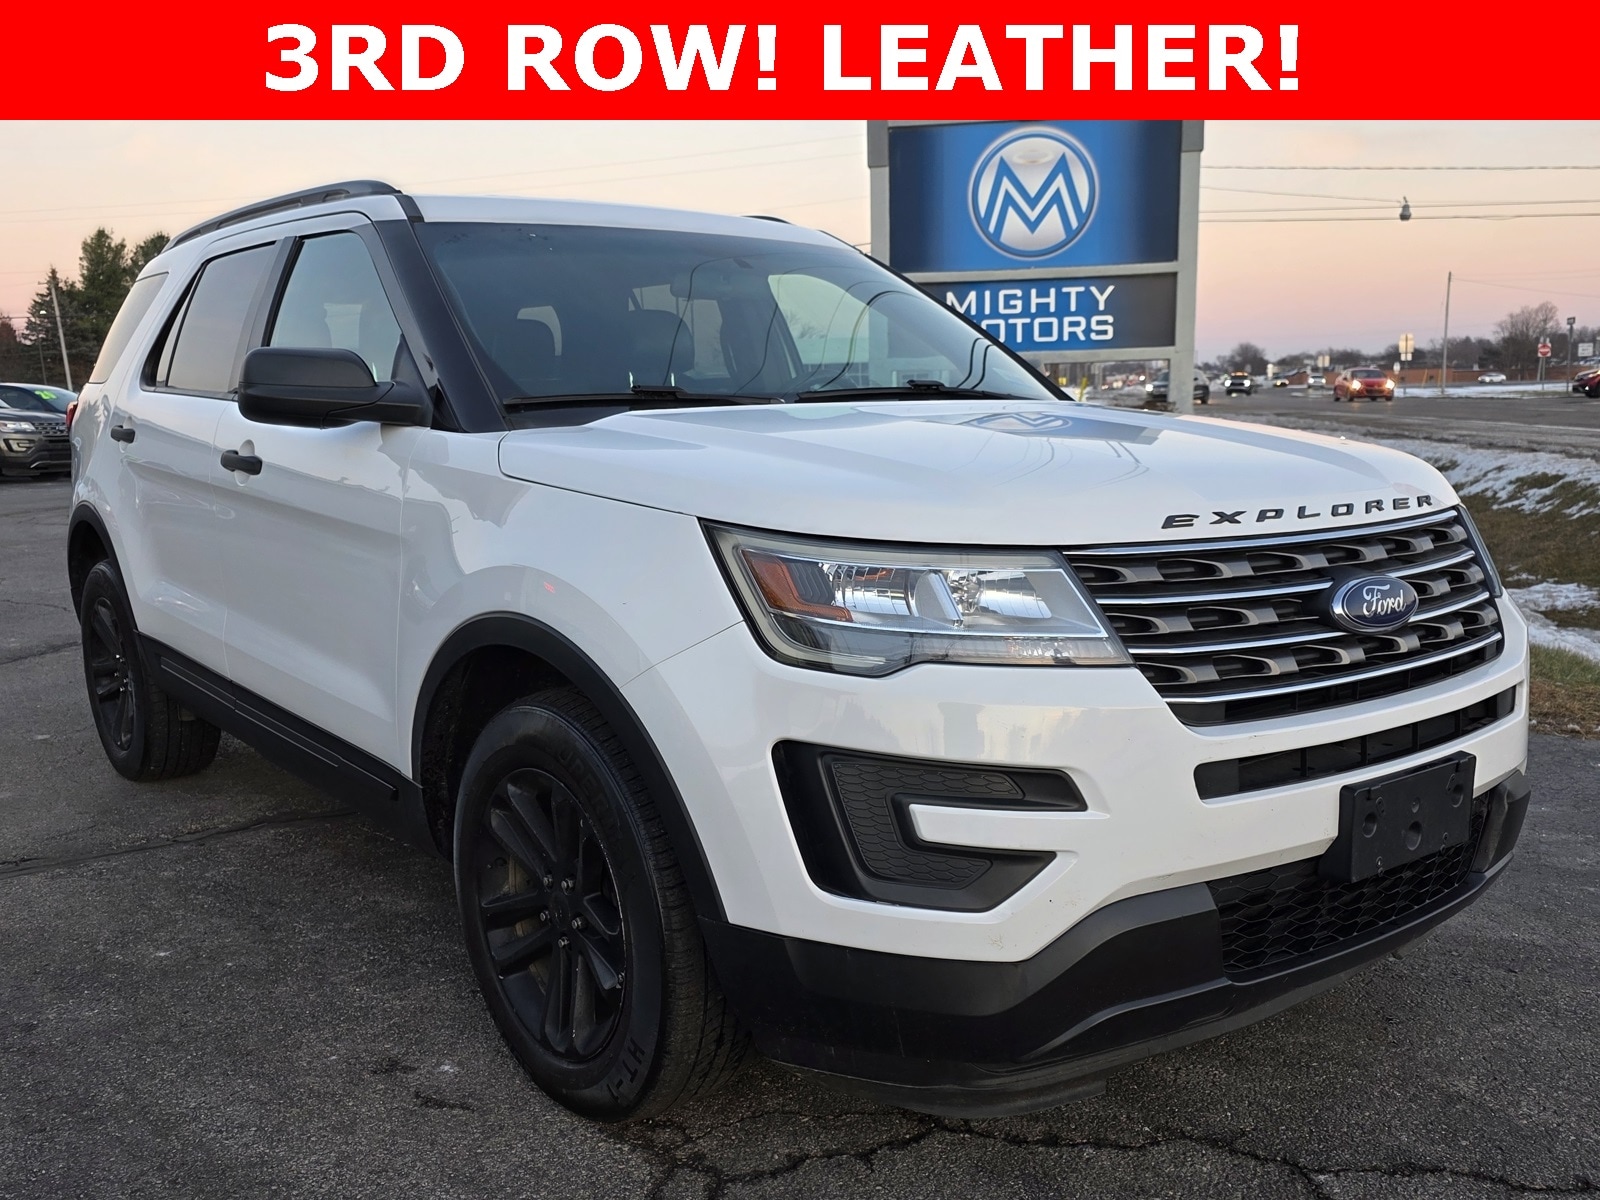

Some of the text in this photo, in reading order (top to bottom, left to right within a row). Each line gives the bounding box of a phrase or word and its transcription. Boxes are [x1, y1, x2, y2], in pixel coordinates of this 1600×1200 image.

[946, 285, 1115, 316] MIGHTY
[973, 315, 1114, 343] OTORS
[1161, 494, 1433, 530] EXPLORER
[1362, 584, 1406, 618] Ford
